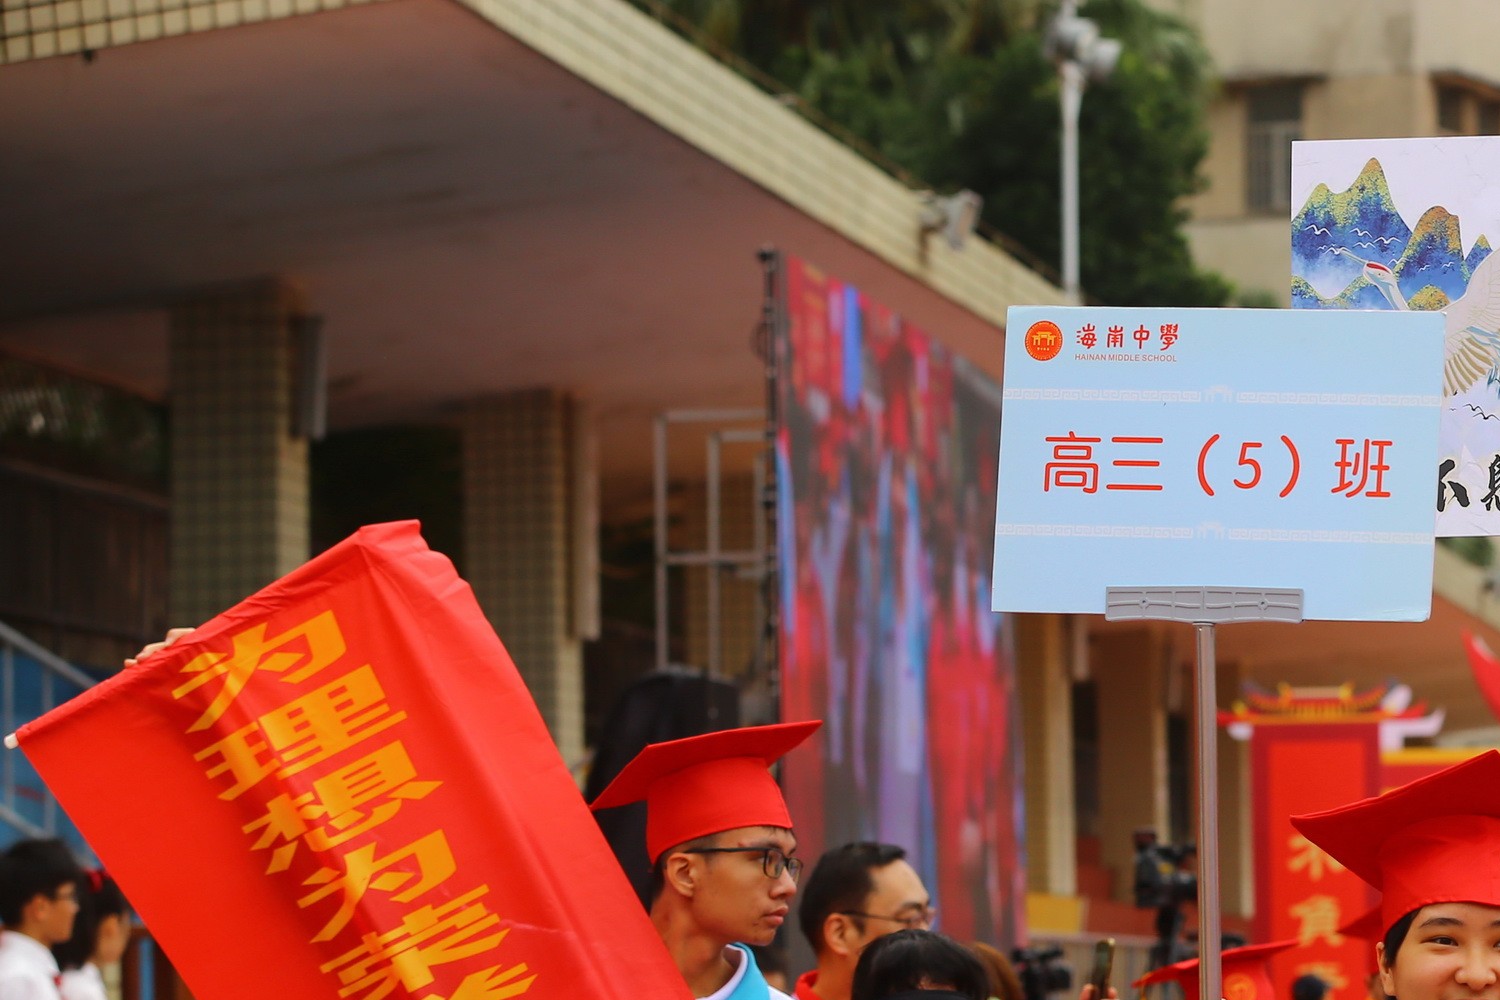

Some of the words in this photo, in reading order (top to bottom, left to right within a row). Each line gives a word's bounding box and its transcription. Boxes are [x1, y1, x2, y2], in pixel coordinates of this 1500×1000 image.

[1075, 353, 1107, 362] HAINAN
[1108, 354, 1140, 362] MIDDLE
[1142, 354, 1177, 363] SCHOOL
